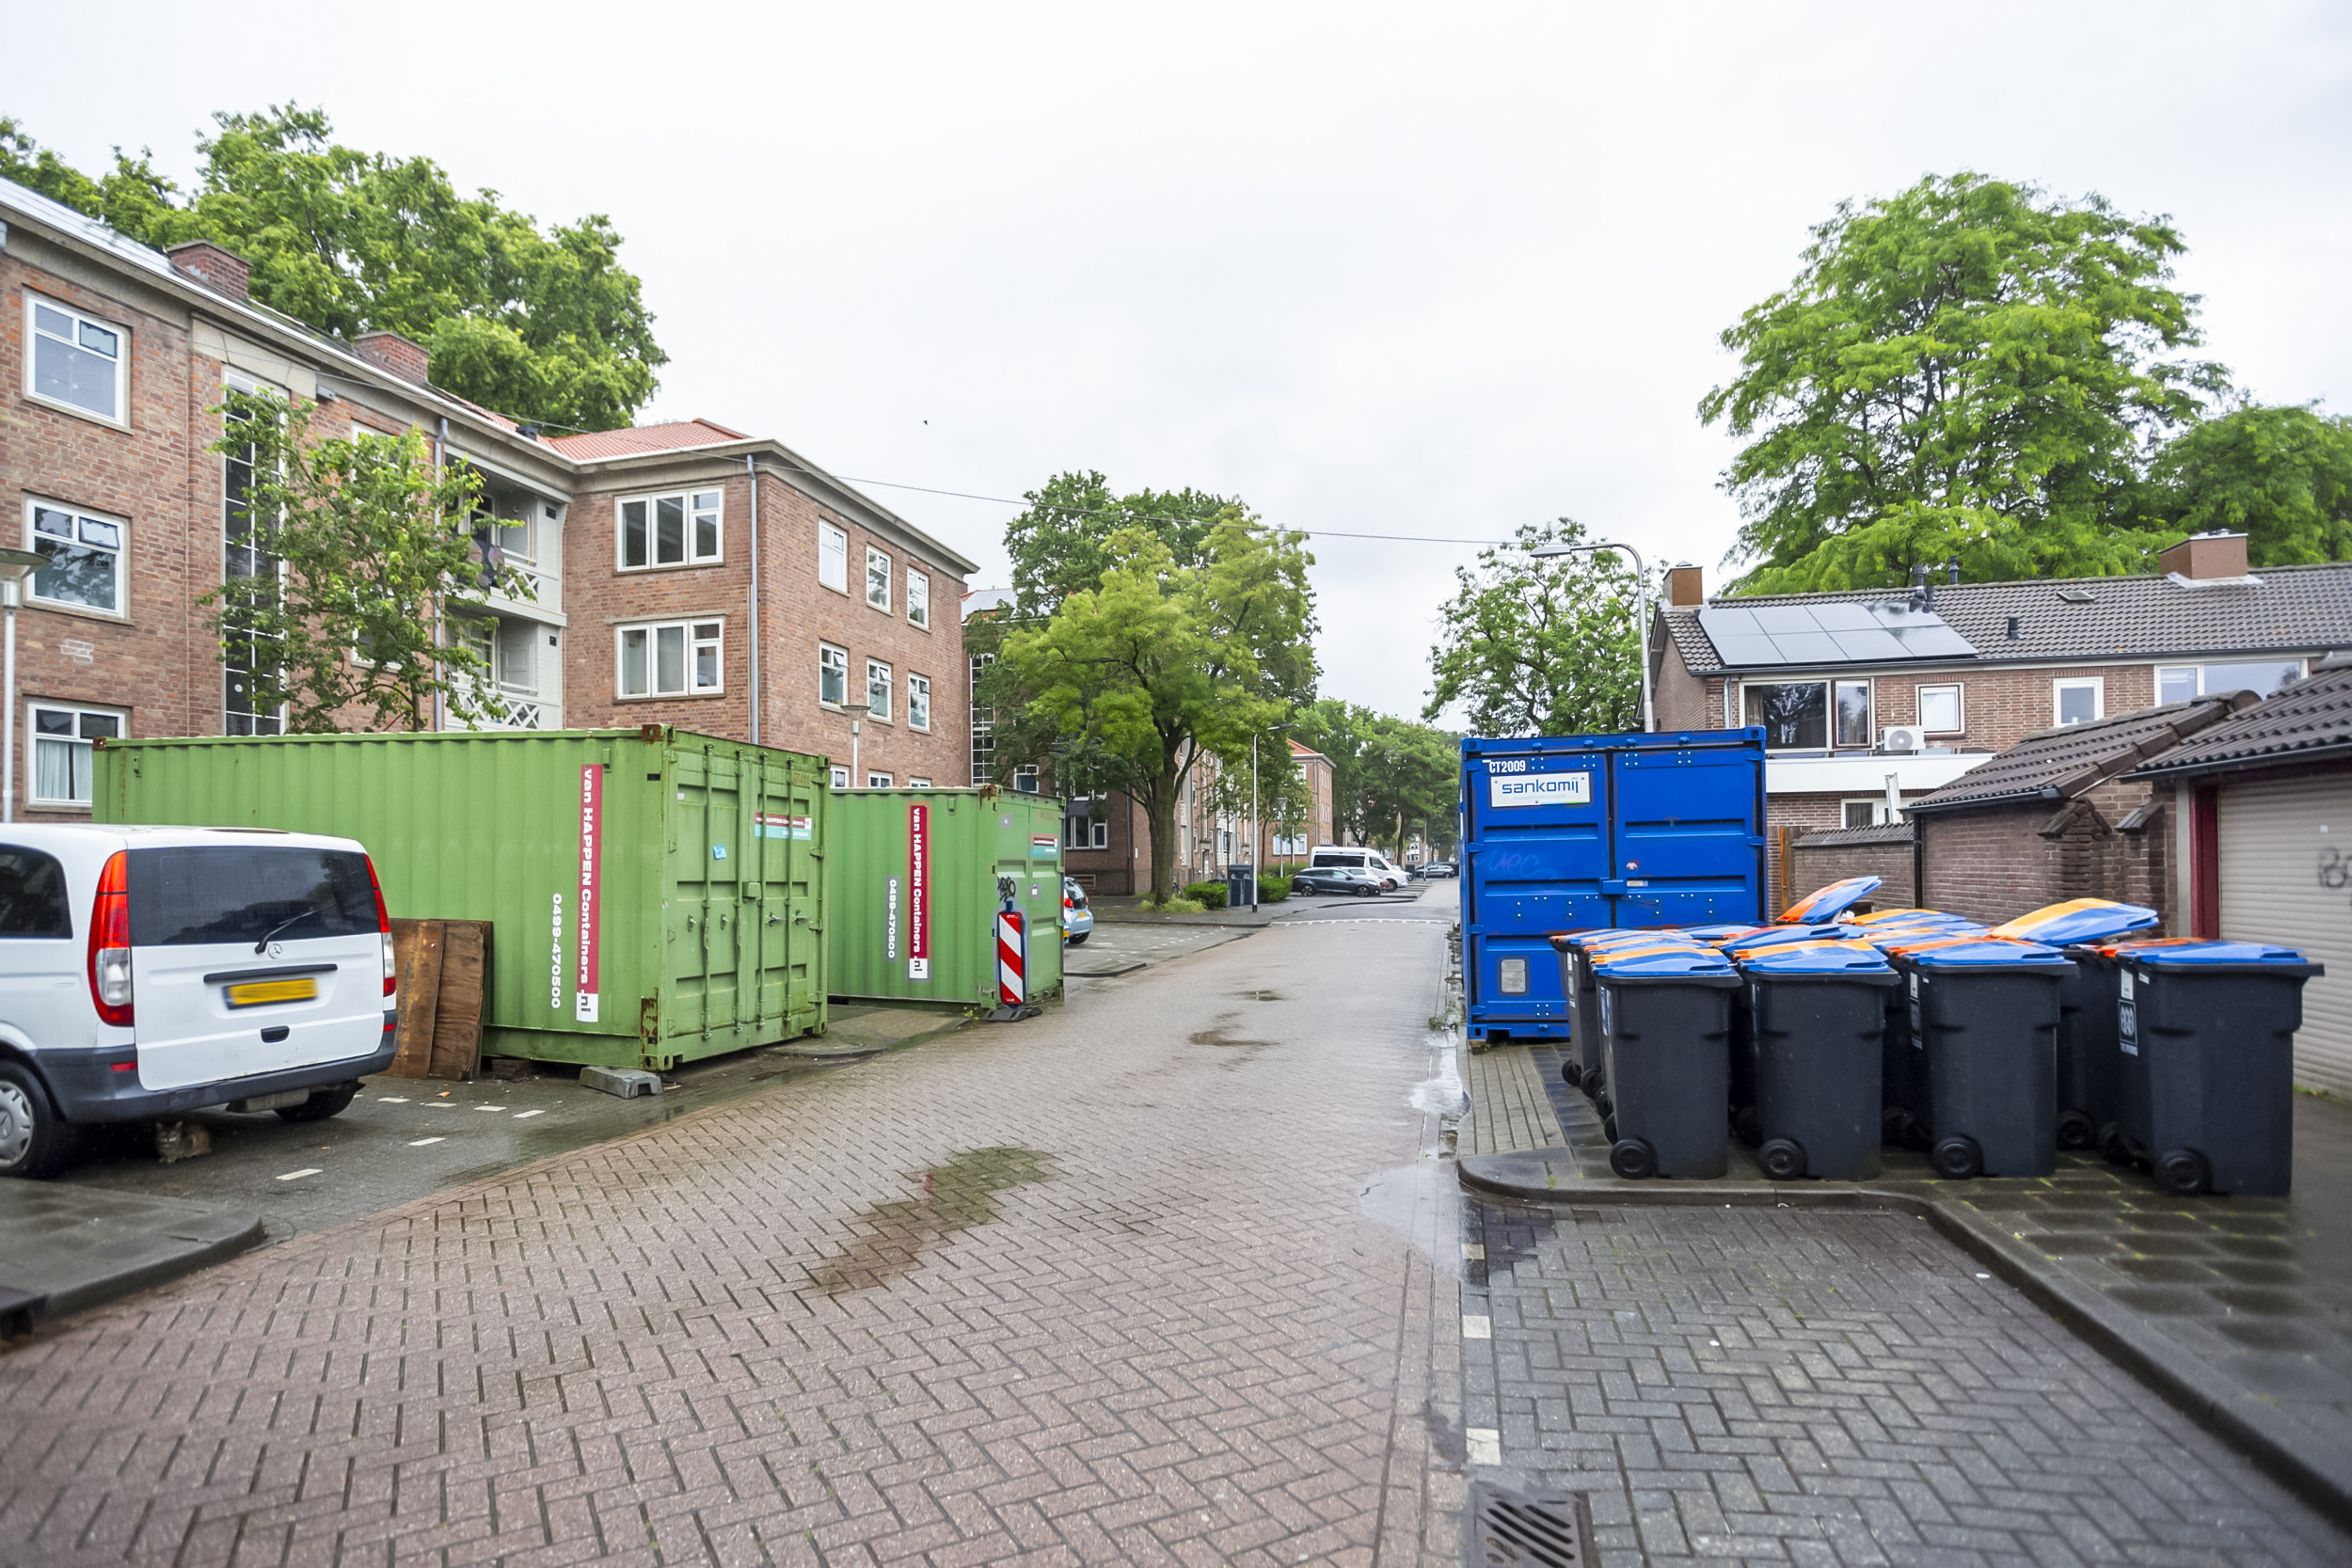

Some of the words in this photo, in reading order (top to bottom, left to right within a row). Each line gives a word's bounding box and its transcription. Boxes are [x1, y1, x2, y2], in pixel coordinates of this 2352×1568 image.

[584, 768, 593, 803] van
[1489, 760, 1526, 773] CT2009
[1502, 778, 1579, 794] sankomij
[582, 807, 593, 886] HAPPEN
[914, 834, 922, 887] HAPPEN
[580, 888, 592, 984] Containers
[888, 879, 897, 958] 0499-470500
[914, 889, 922, 953] Containers
[551, 894, 562, 1008] 0499-470500
[580, 990, 592, 1012] .nl
